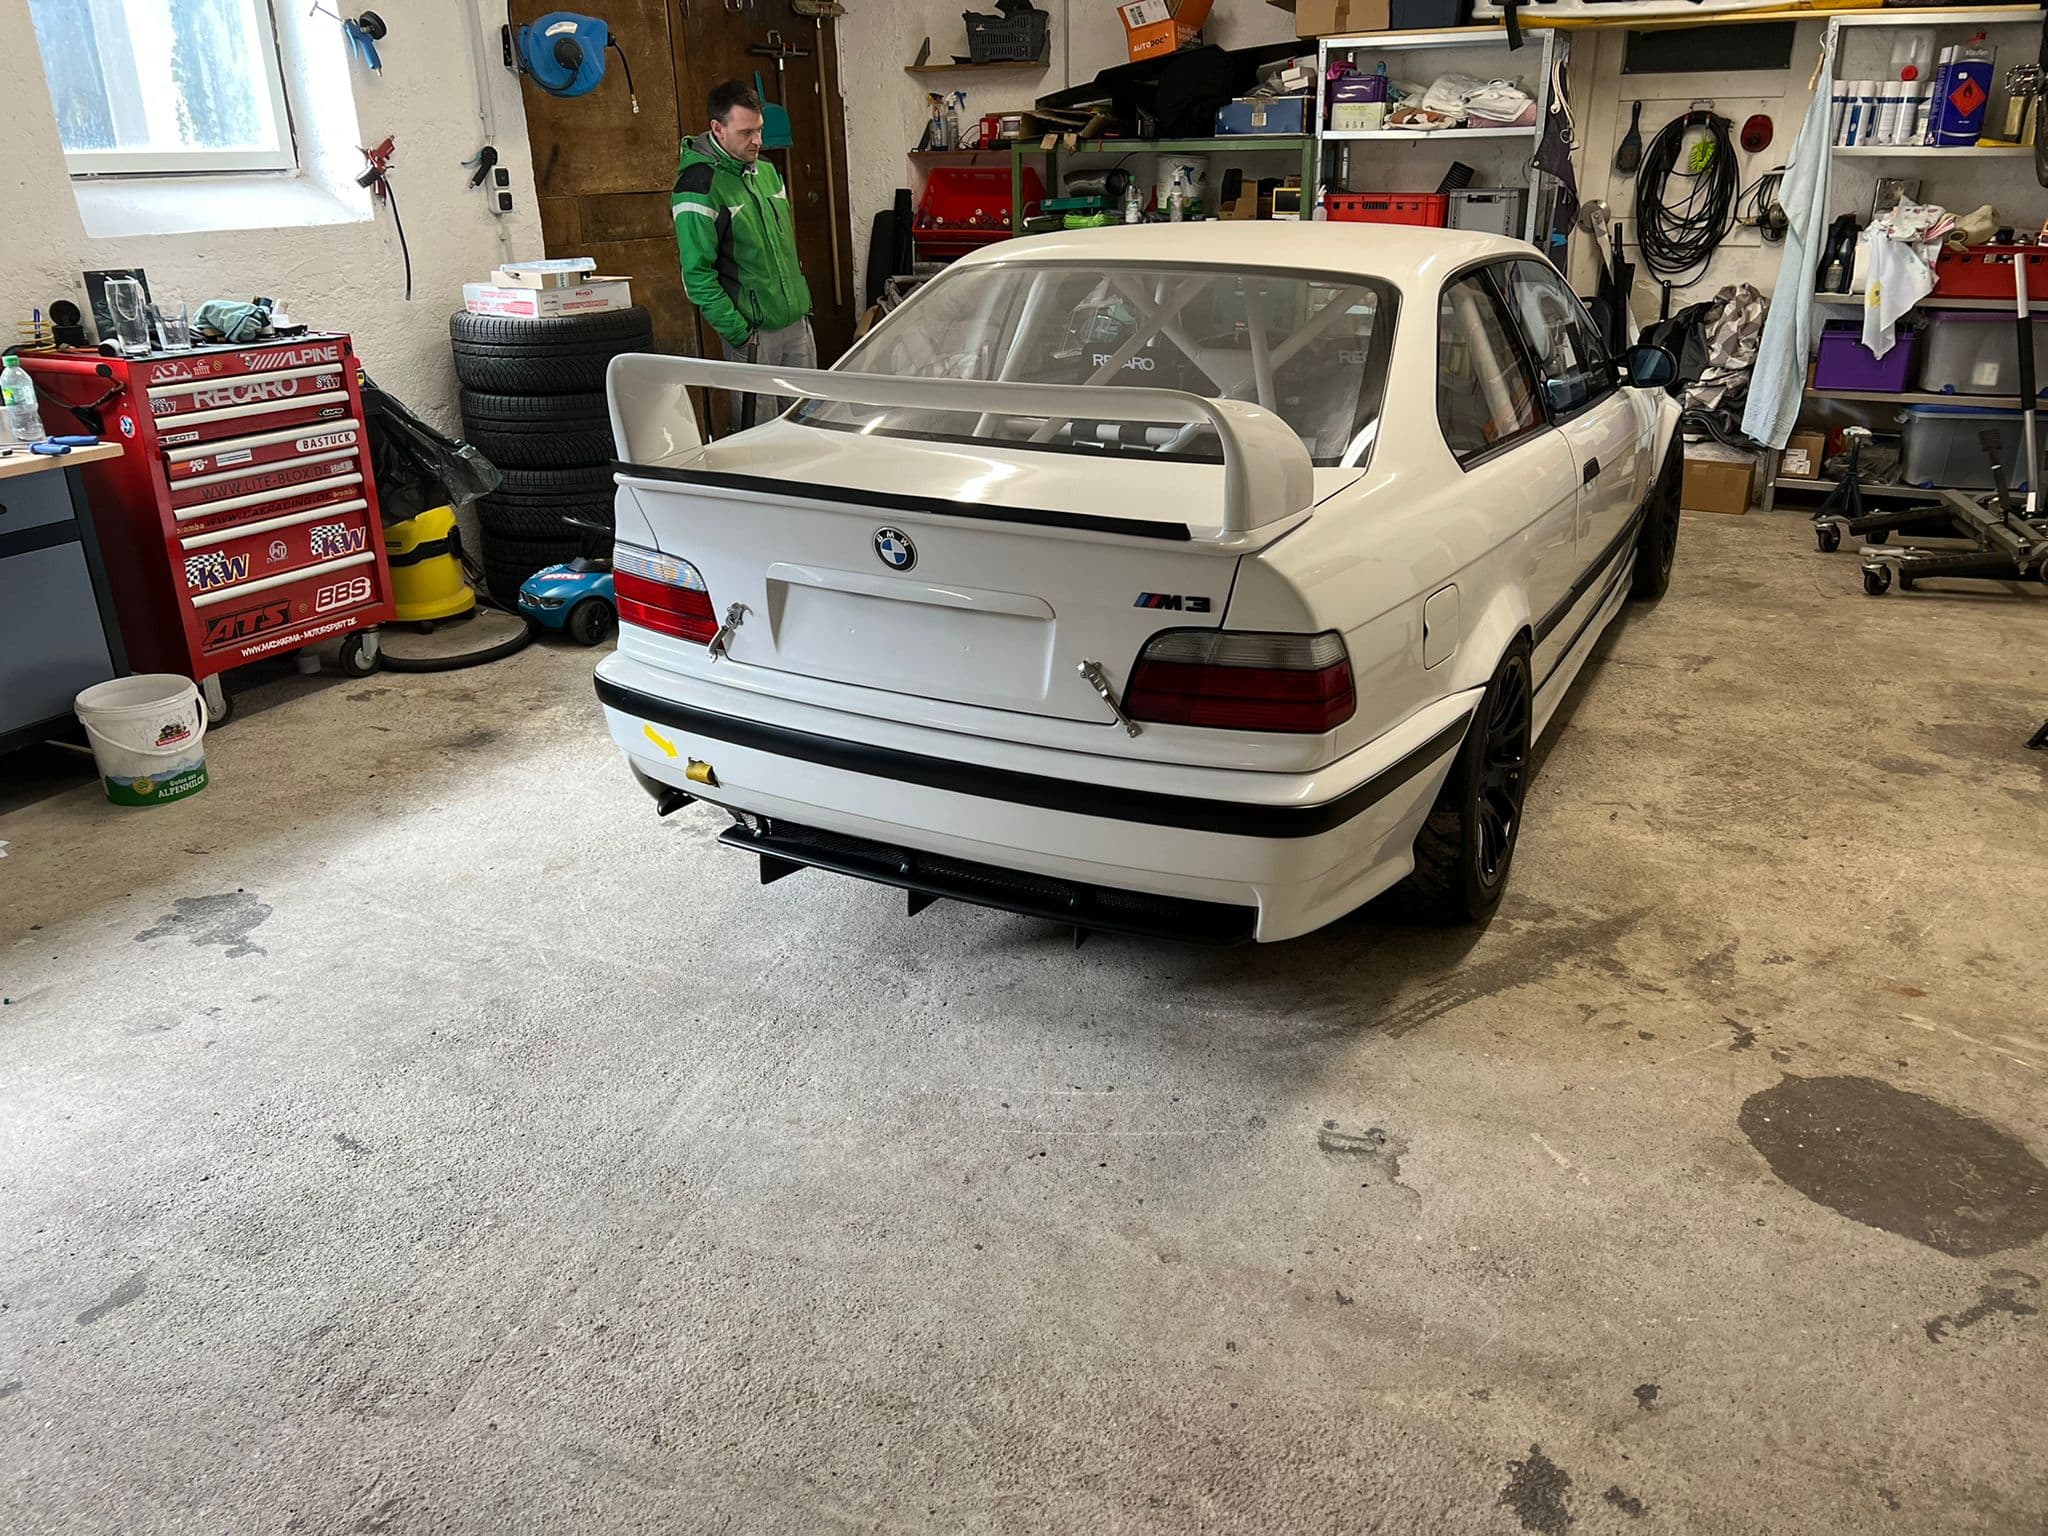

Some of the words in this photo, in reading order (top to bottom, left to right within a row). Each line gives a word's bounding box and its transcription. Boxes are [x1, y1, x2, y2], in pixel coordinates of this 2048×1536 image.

[1133, 35, 1164, 52] AUTODOC
[279, 345, 340, 367] ALPINE
[1092, 353, 1156, 371] REARO
[150, 361, 193, 384] ASA
[193, 379, 299, 409] RECARO
[167, 432, 198, 443] SCOTT
[302, 432, 352, 450] BASTUCK
[321, 526, 366, 560] KW
[199, 553, 250, 590] KW
[315, 577, 371, 612] BBS
[203, 600, 292, 648] ATS
